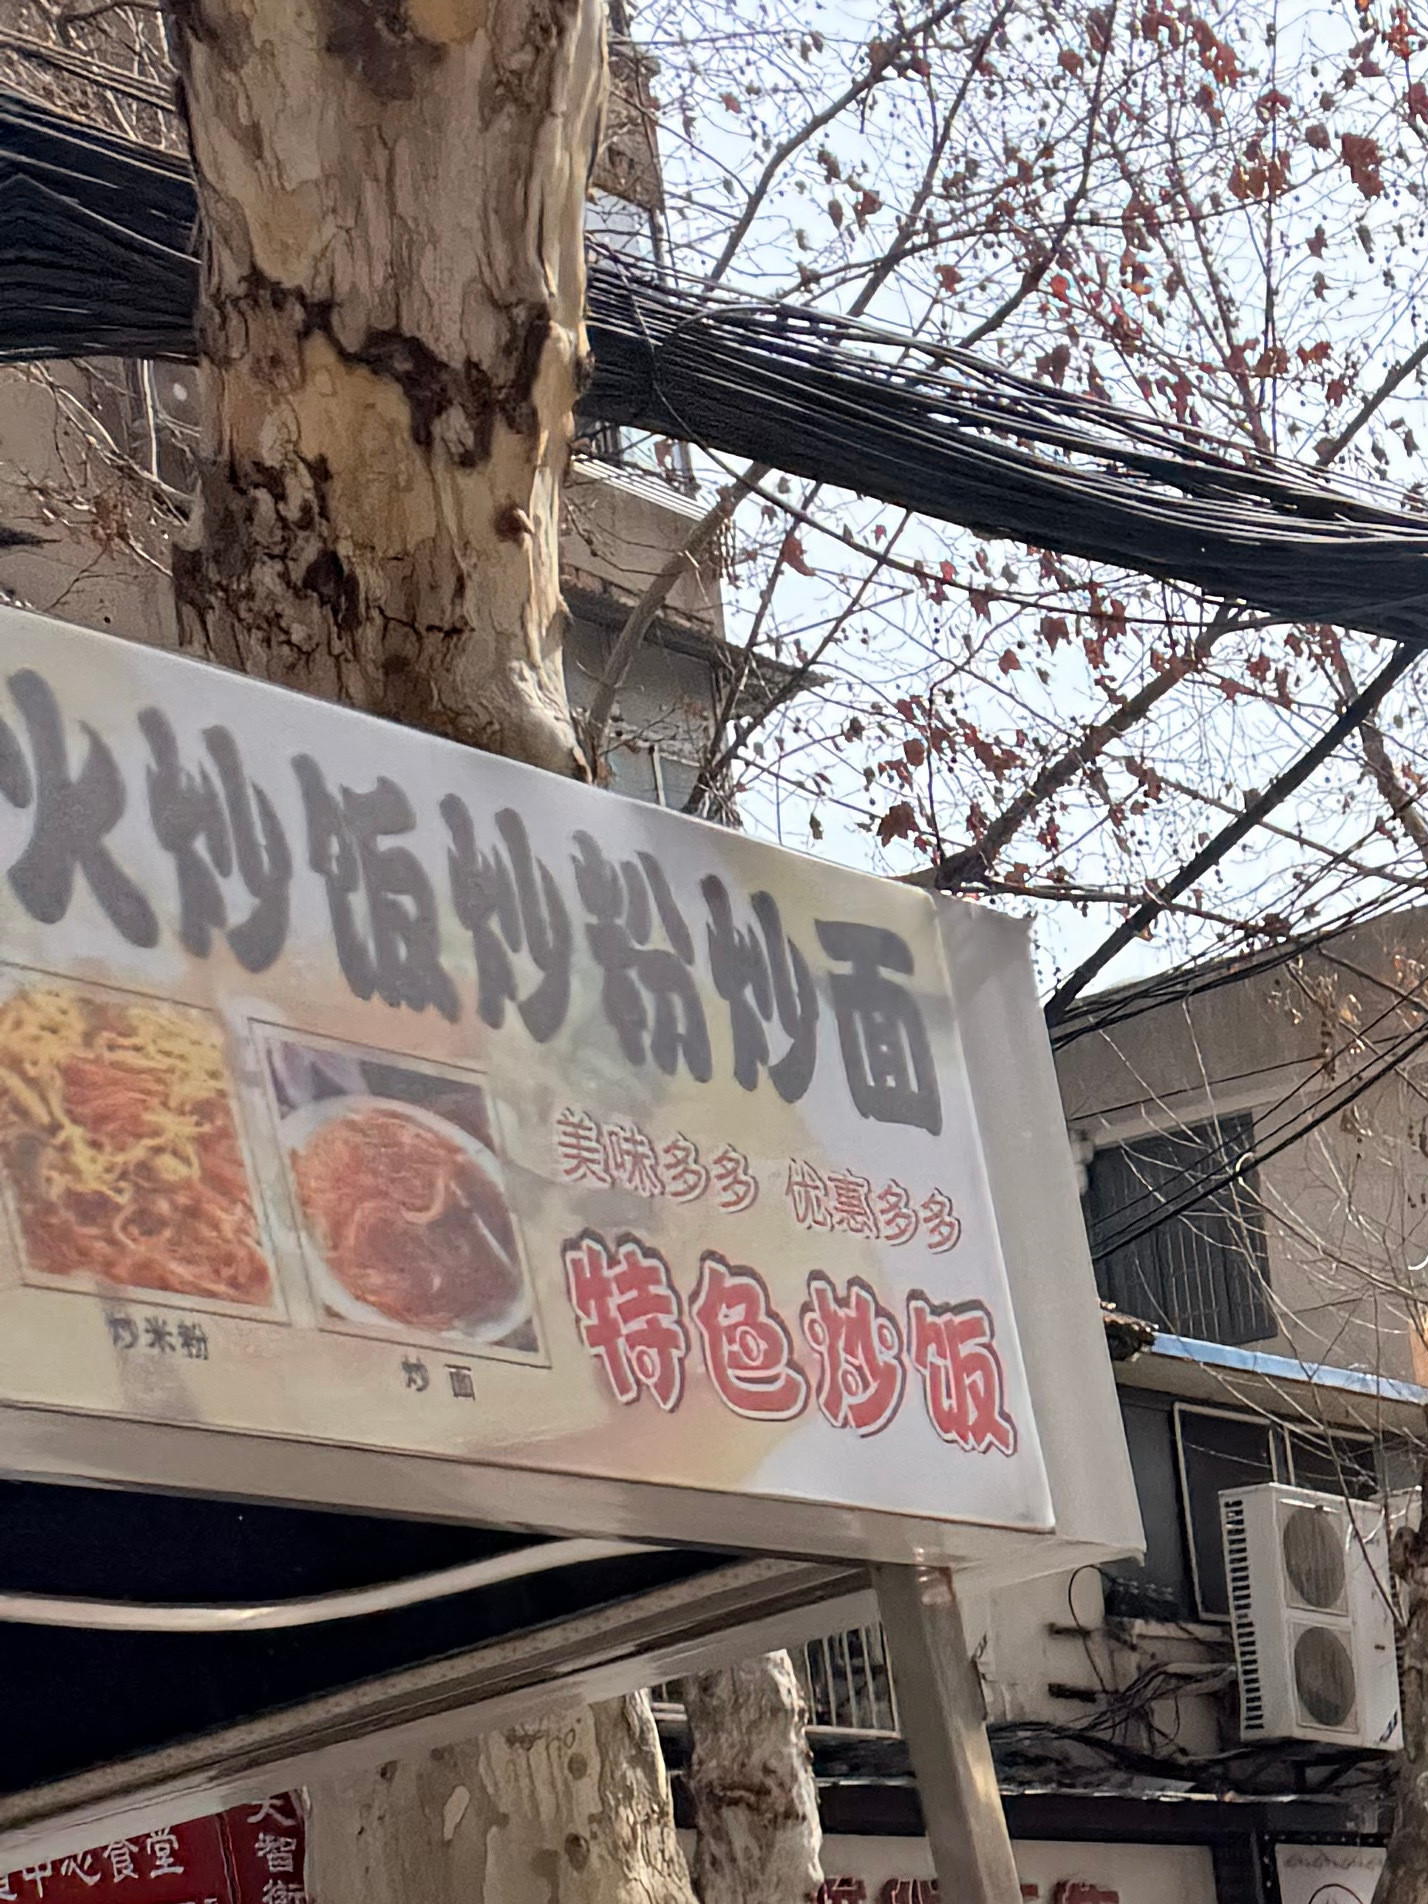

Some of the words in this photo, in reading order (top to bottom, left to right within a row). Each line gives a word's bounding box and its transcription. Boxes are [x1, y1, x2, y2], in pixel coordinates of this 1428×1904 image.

[556, 1107, 760, 1214] 美味多多
[785, 1157, 962, 1254] 优惠多多
[563, 1228, 1018, 1457] 特色炒饭
[0, 1827, 184, 1900] 中心食堂
